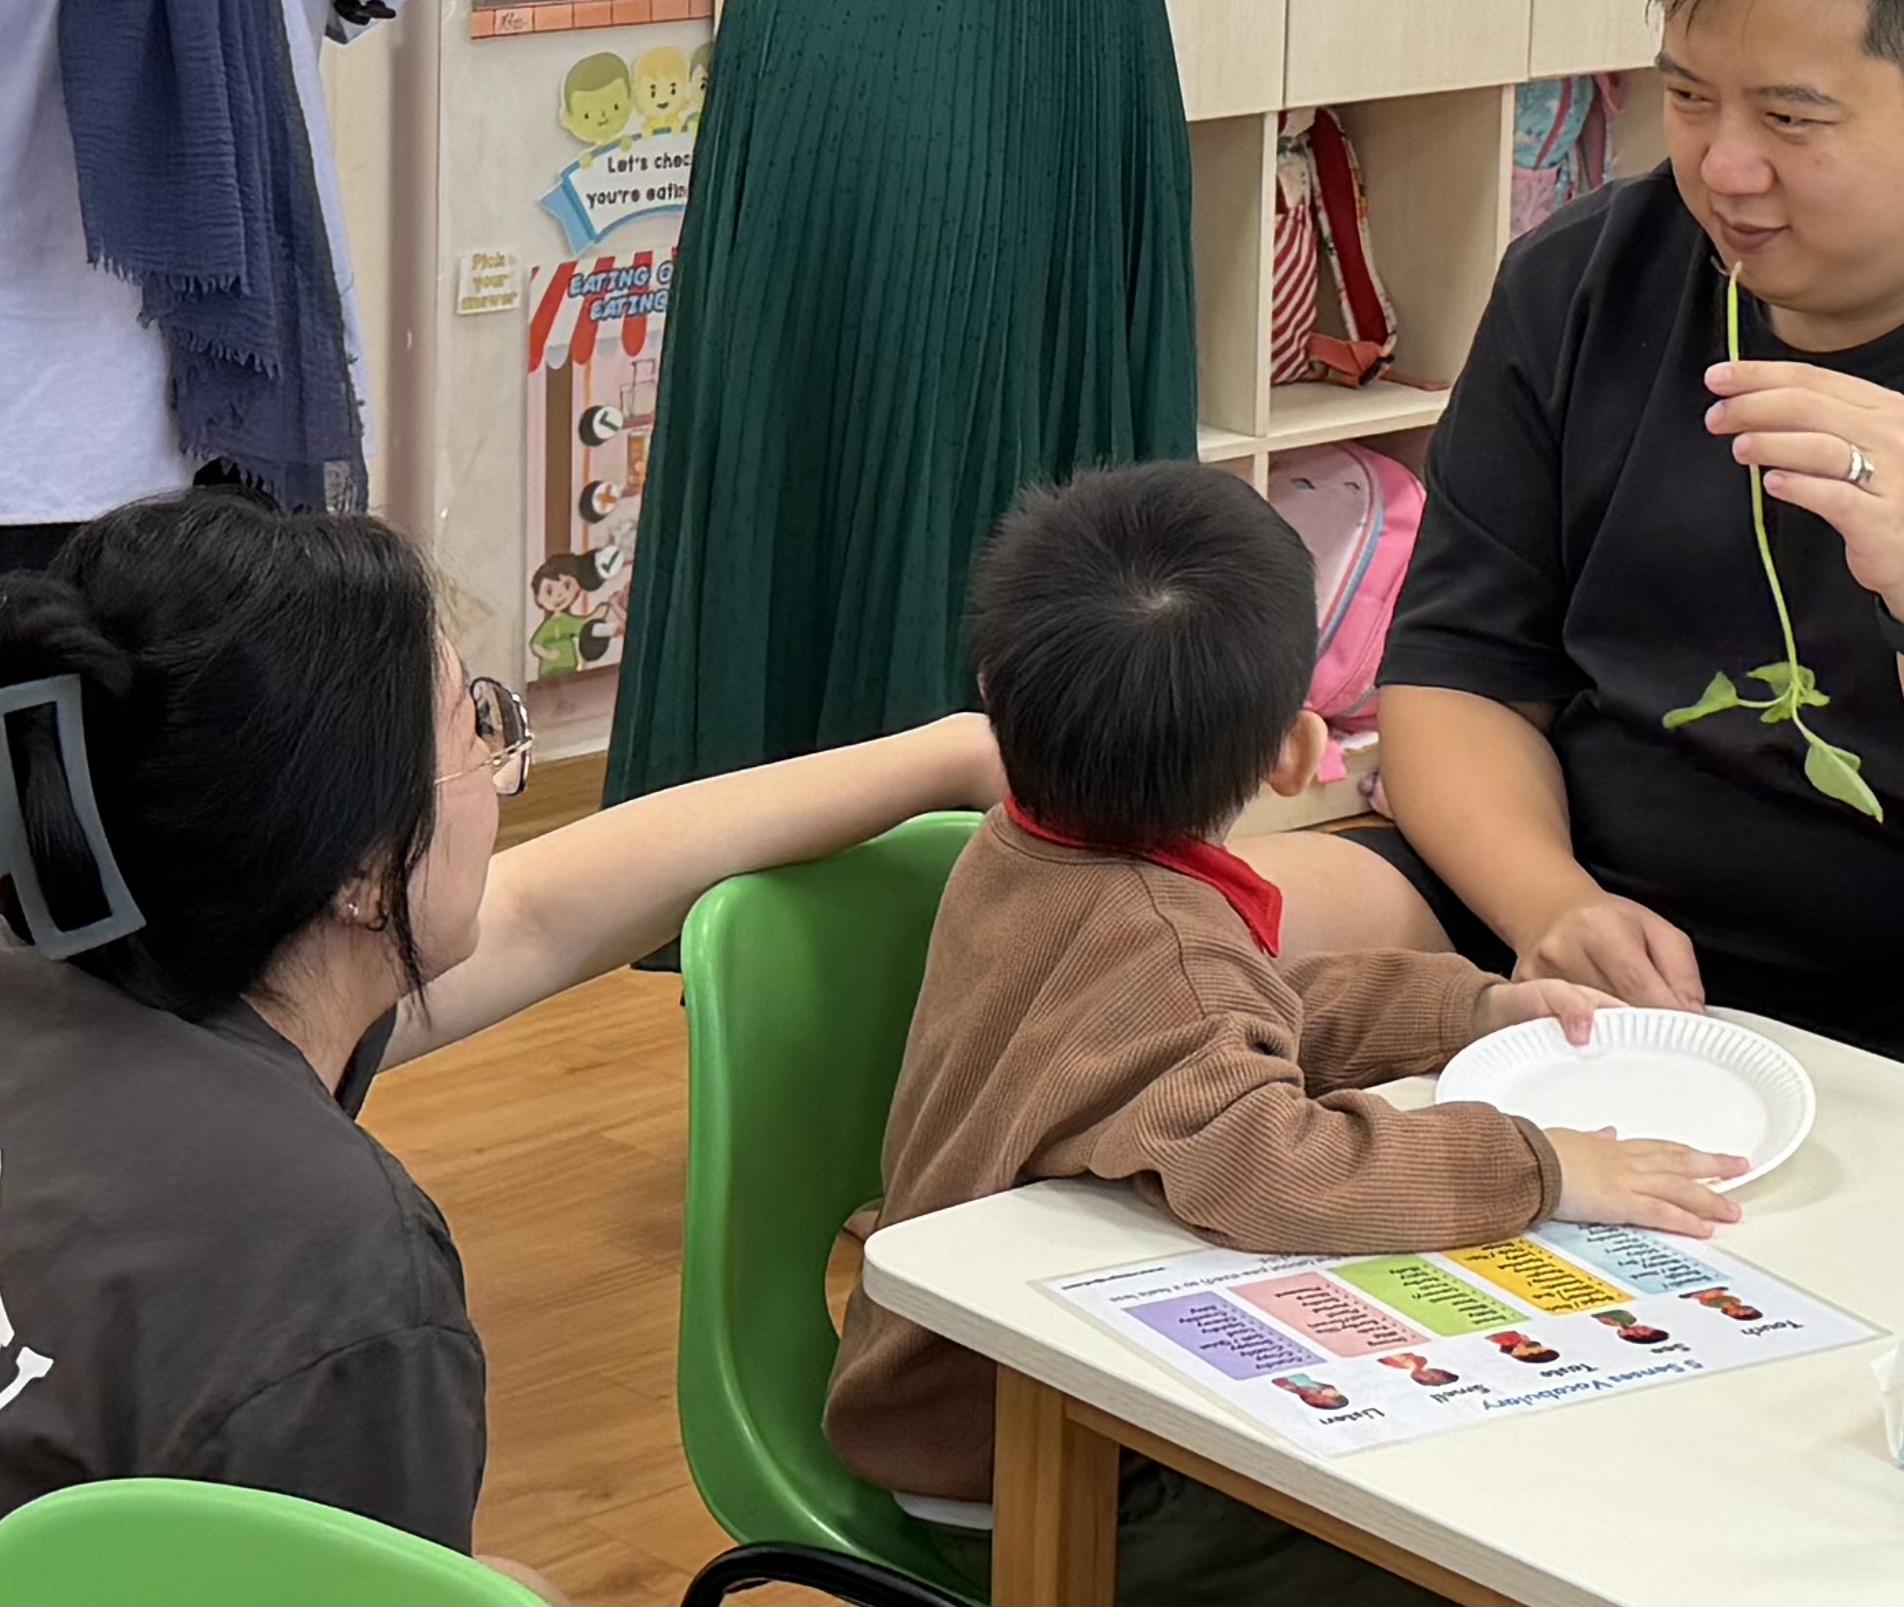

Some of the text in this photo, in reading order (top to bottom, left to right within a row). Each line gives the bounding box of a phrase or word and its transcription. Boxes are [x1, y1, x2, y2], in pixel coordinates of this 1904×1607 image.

[607, 152, 691, 174] Let's chec
[586, 182, 688, 210] you're eatin
[471, 251, 506, 269] Pick
[472, 273, 510, 293] your
[568, 267, 652, 298] EATING
[461, 291, 518, 311] answer
[1740, 1319, 1803, 1336] Touch
[1650, 1342, 1690, 1354] See
[1539, 1363, 1597, 1377] Taste
[1607, 1363, 1685, 1382] Senses
[1429, 1384, 1490, 1403] Smell
[1482, 1379, 1612, 1409] Vocabulary
[1319, 1407, 1385, 1425] Listen
